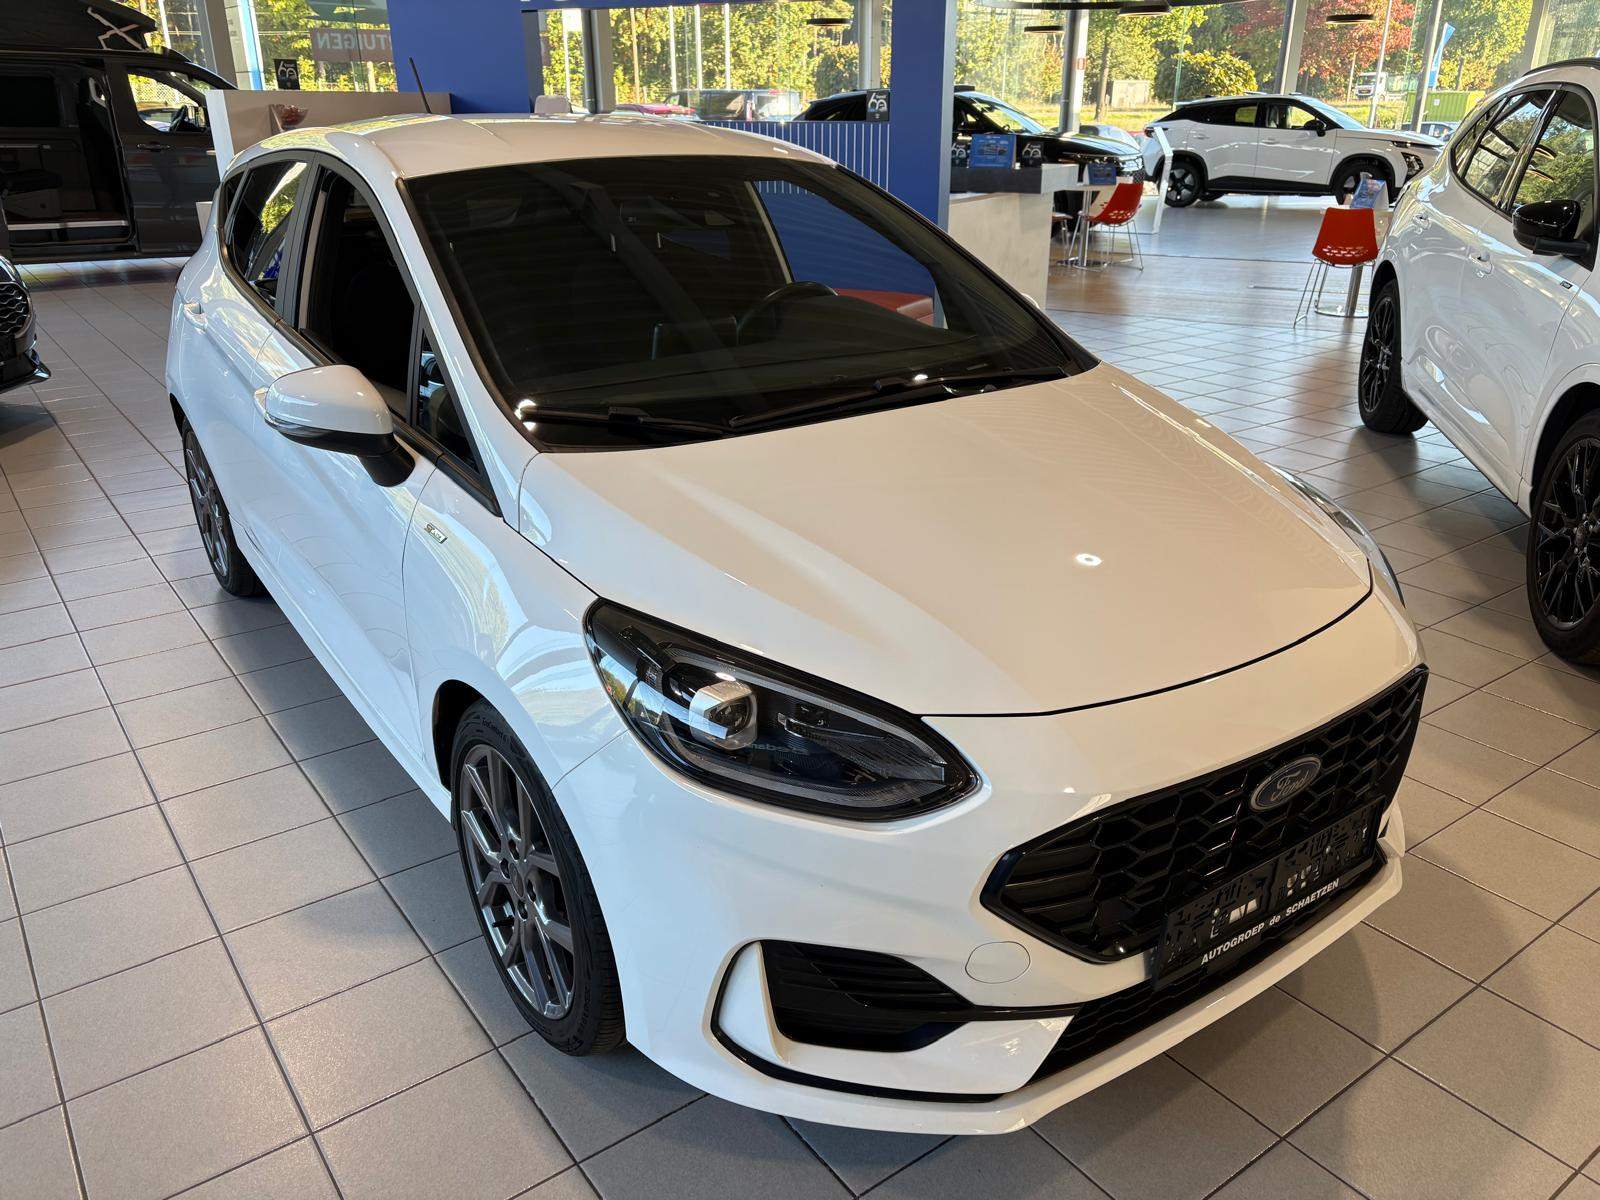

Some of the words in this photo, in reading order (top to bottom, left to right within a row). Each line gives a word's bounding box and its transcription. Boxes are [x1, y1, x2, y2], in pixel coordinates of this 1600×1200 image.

[1270, 769, 1312, 801] Ford
[1200, 922, 1265, 965] AUTOGROEP
[1269, 915, 1281, 926] de
[1285, 878, 1340, 916] SCHAETZEN
